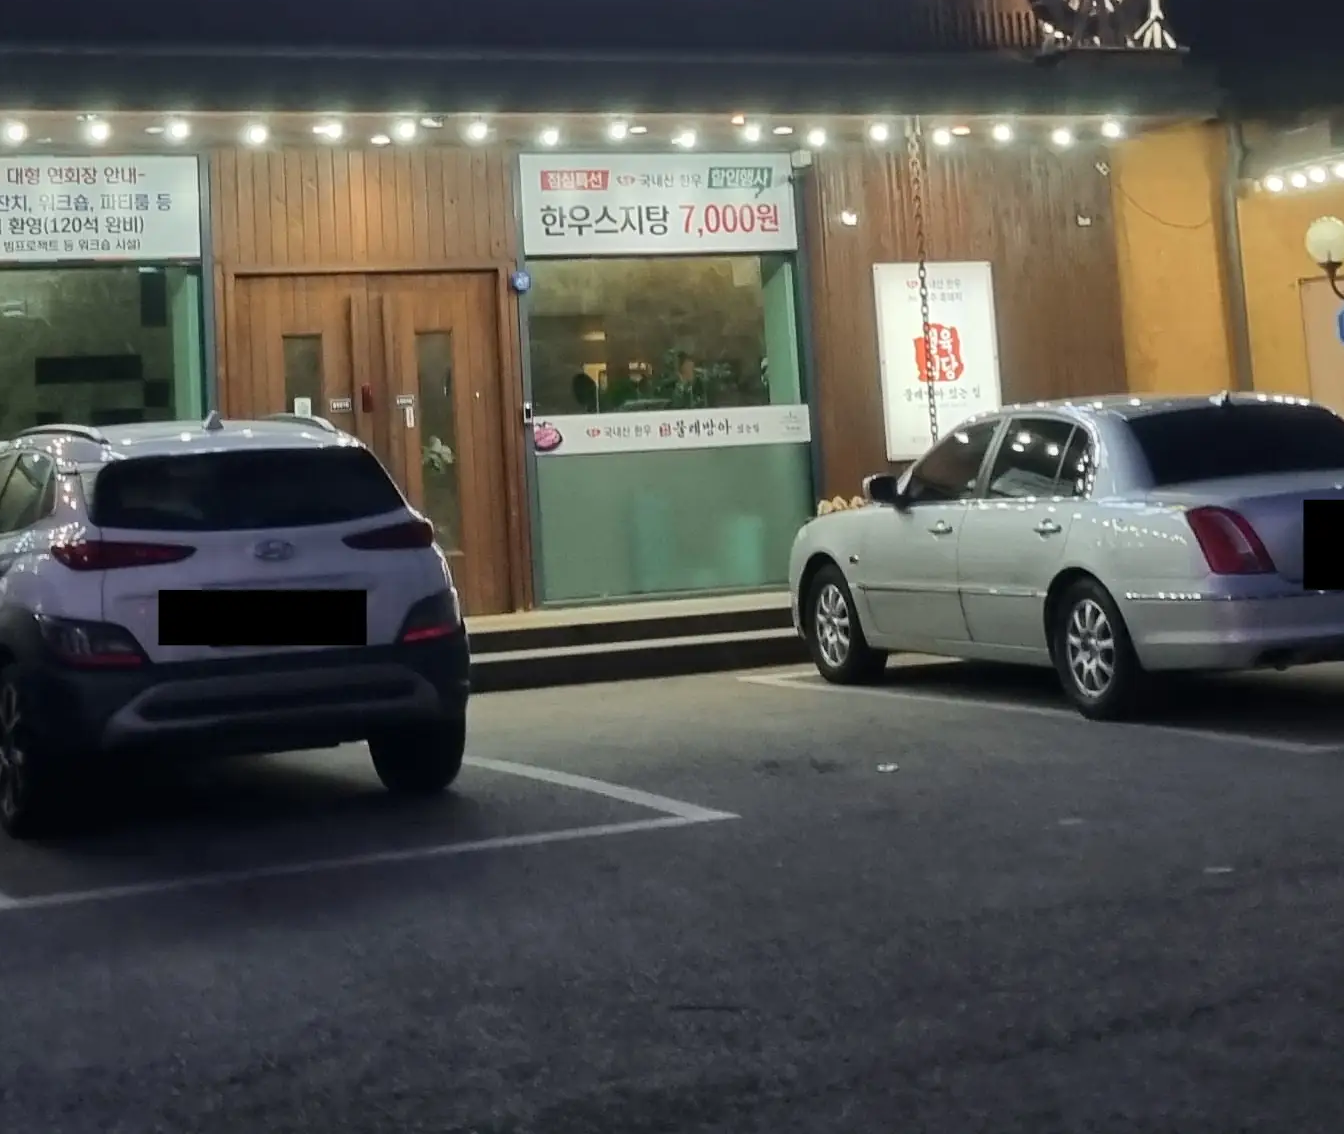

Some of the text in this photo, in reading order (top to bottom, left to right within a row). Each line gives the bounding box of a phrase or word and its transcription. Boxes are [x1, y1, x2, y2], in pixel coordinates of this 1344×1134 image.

[6, 166, 41, 185] 대형
[47, 166, 97, 185] 연회장
[156, 193, 172, 211] 등
[540, 203, 780, 239] 한우스지탕 7,000원
